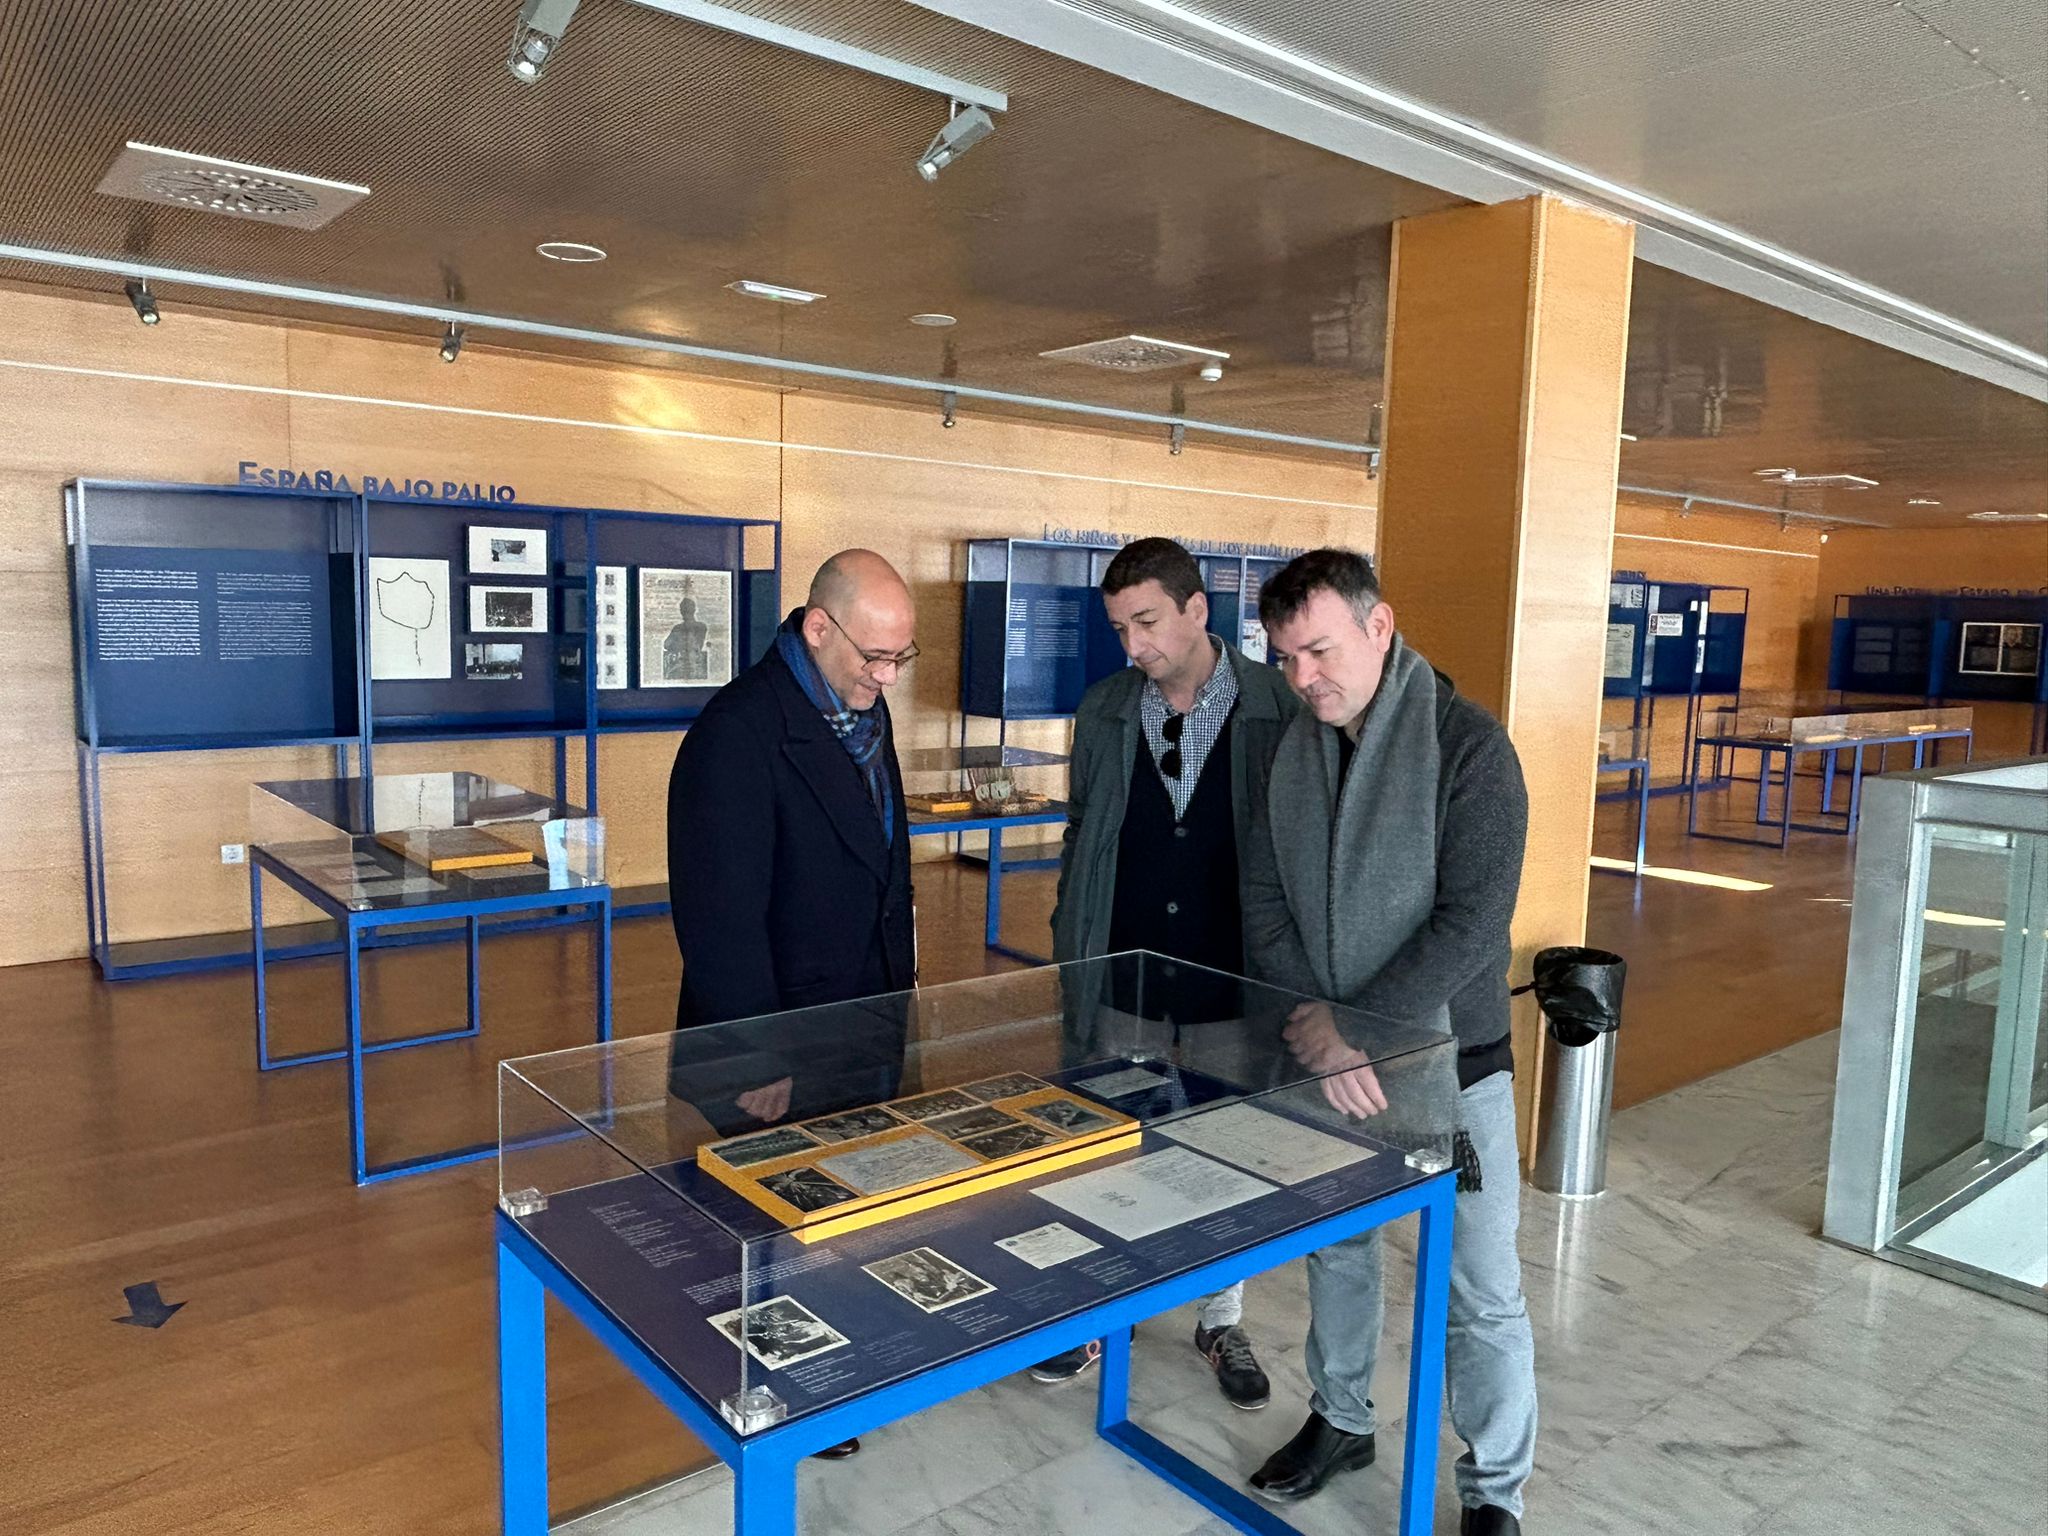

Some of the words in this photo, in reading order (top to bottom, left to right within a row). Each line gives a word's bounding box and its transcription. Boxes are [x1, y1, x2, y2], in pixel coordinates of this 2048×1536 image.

[239, 461, 352, 491] ESPAÑA
[363, 475, 434, 498] BAJO
[442, 481, 516, 503] PALIO
